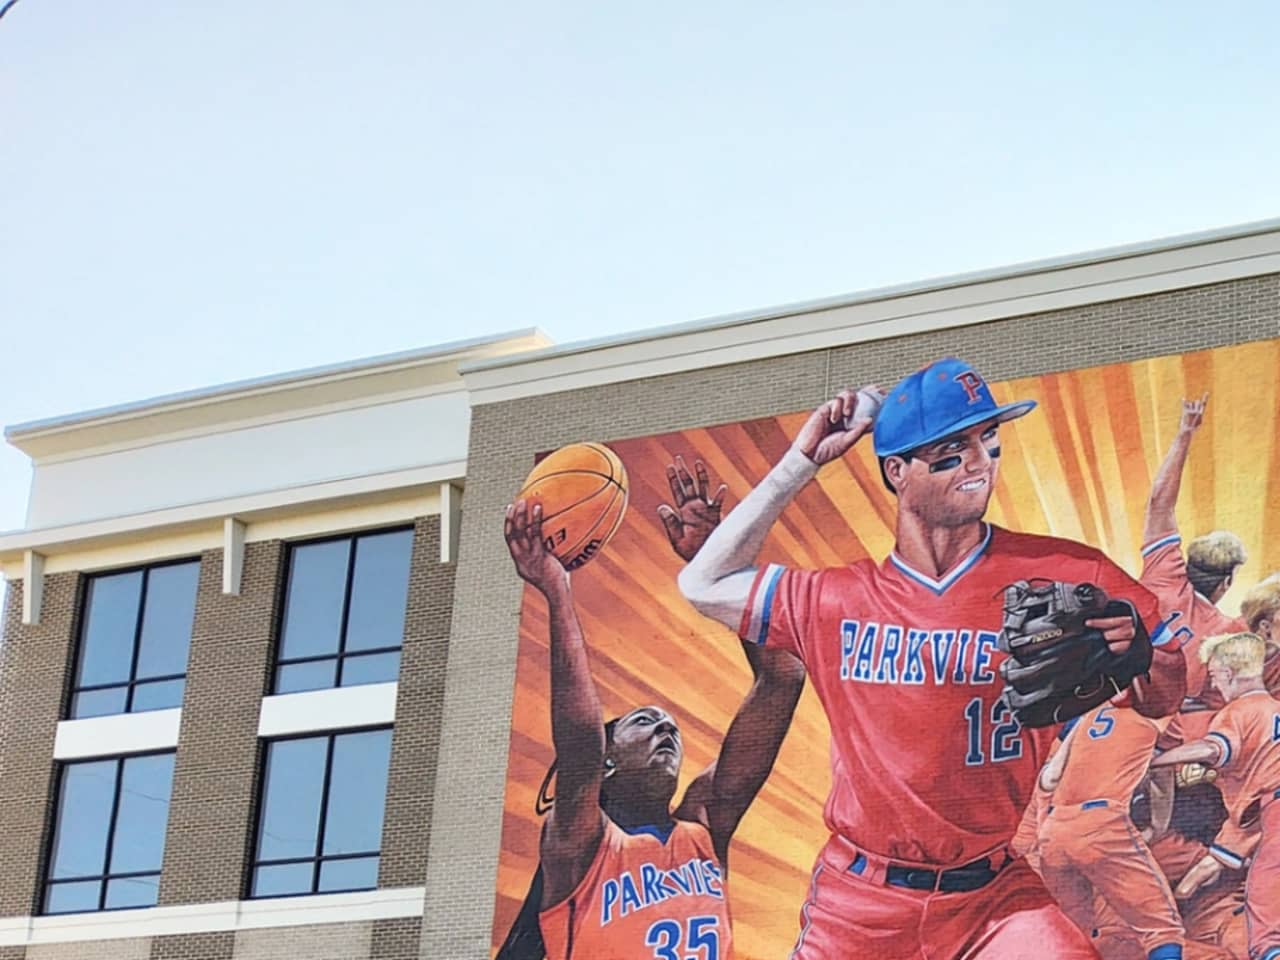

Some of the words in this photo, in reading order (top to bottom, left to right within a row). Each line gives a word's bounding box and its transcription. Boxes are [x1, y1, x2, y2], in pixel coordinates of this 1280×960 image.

[953, 370, 982, 405] P
[840, 619, 1001, 686] PARKVIE
[965, 697, 1022, 766] 12
[601, 858, 725, 927] PARKVIE
